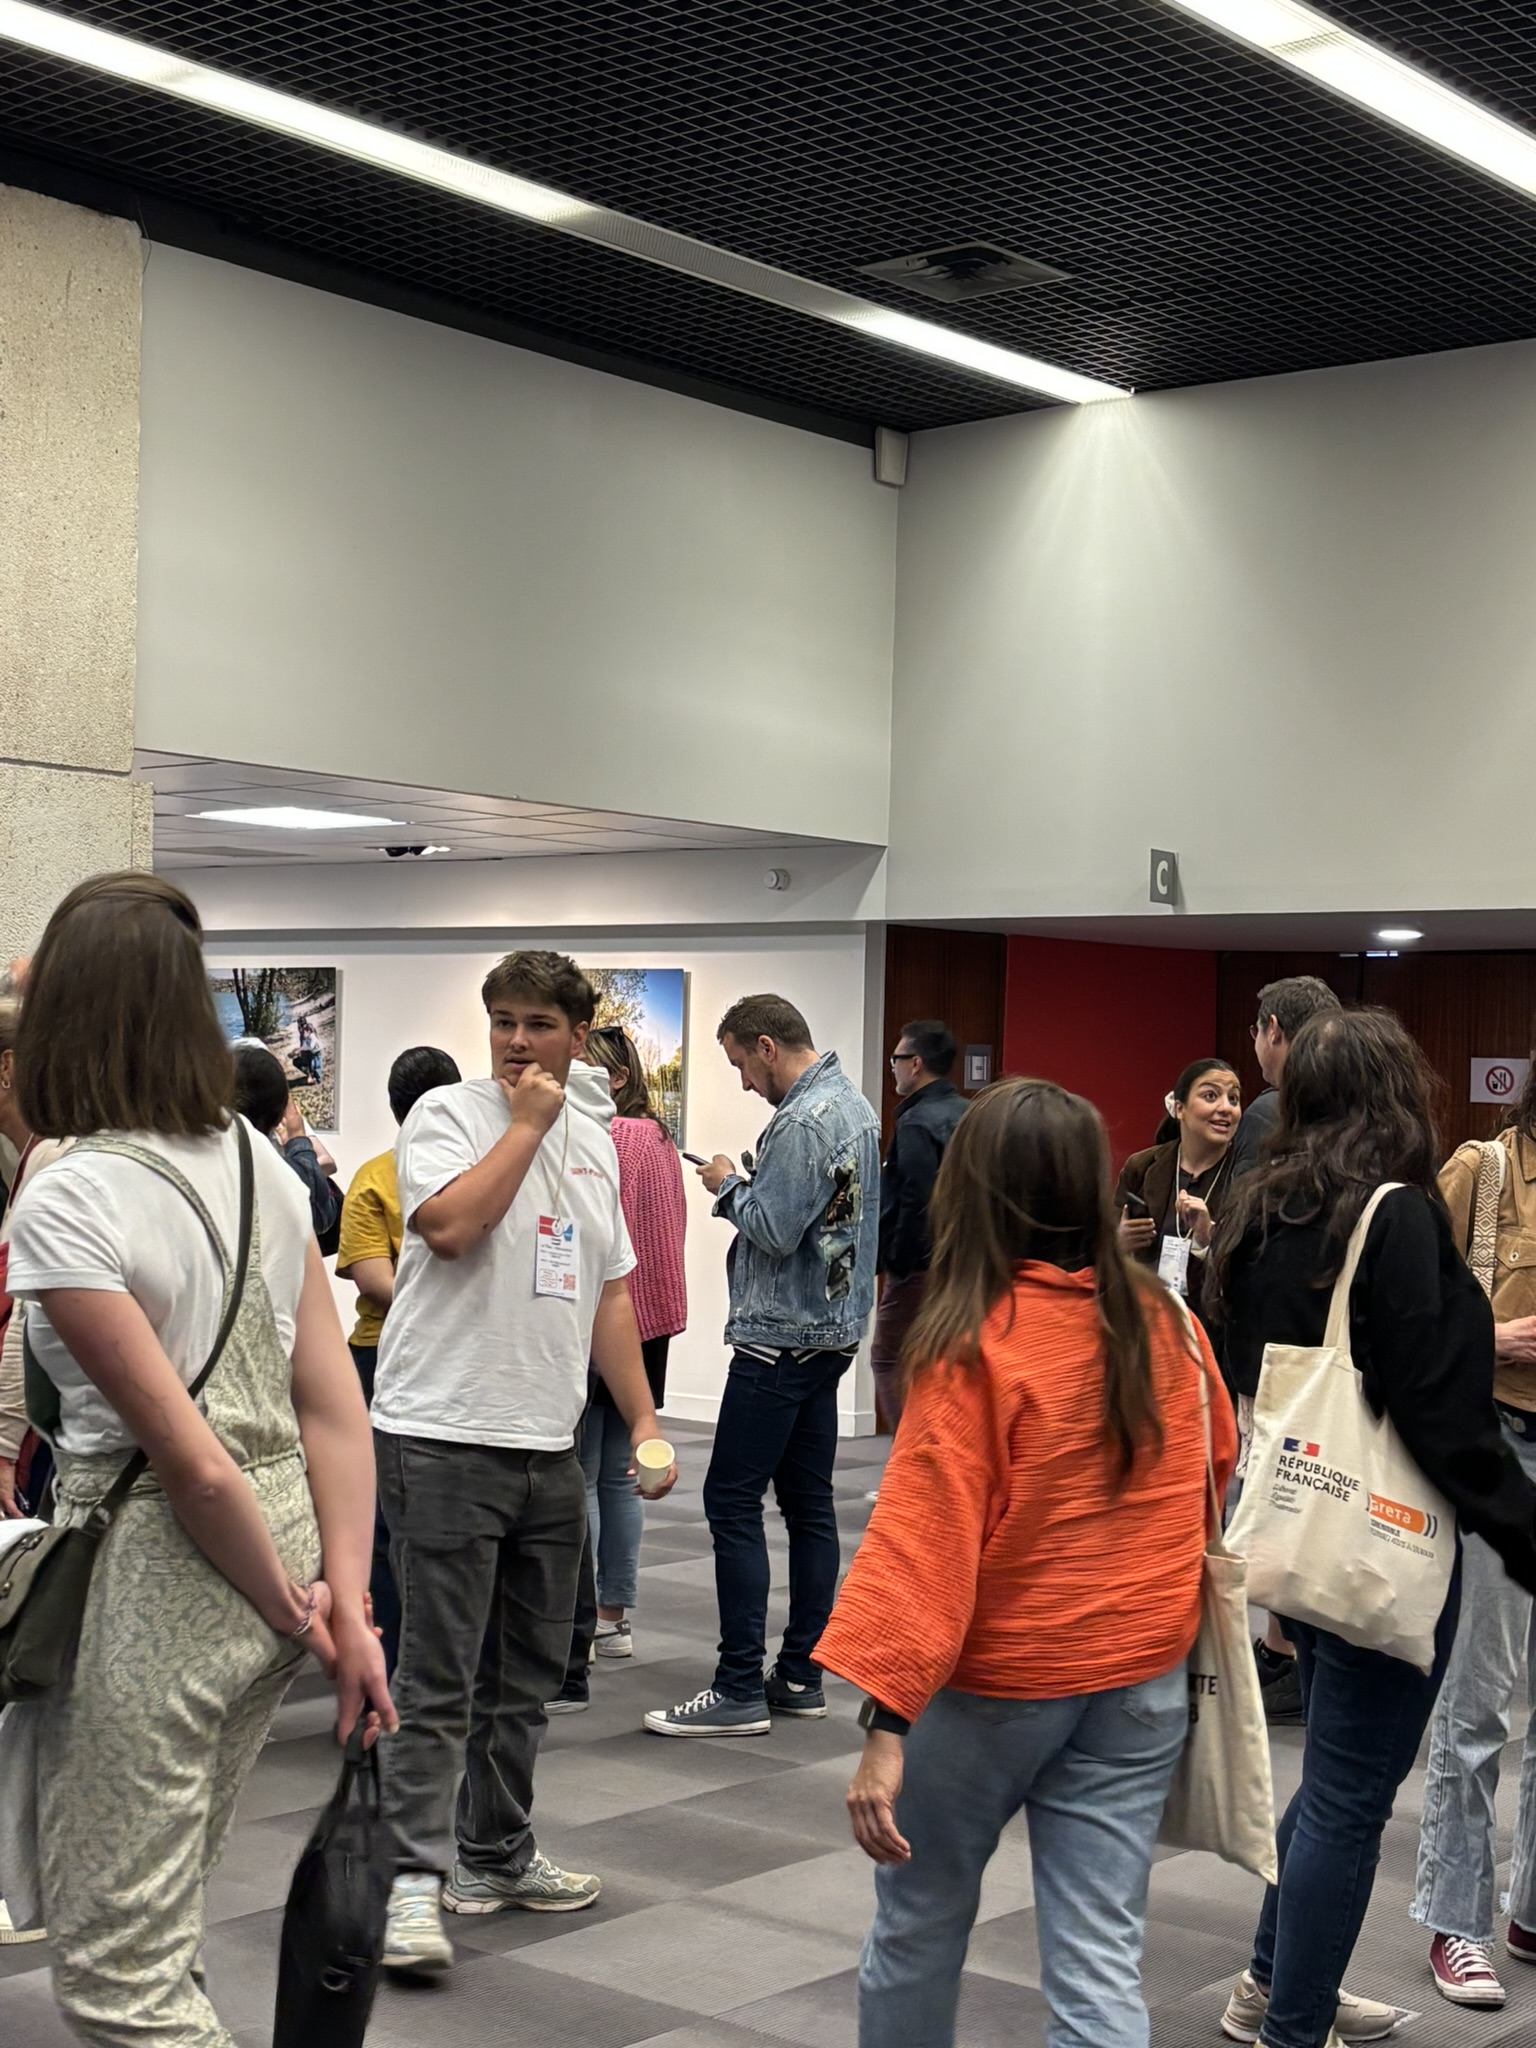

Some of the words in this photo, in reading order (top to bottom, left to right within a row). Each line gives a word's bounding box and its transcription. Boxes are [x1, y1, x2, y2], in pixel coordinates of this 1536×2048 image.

[1157, 860, 1168, 895] C
[1275, 1468, 1351, 1502] FRANÇAISE
[1279, 1455, 1360, 1491] RÉPUBLIQUE
